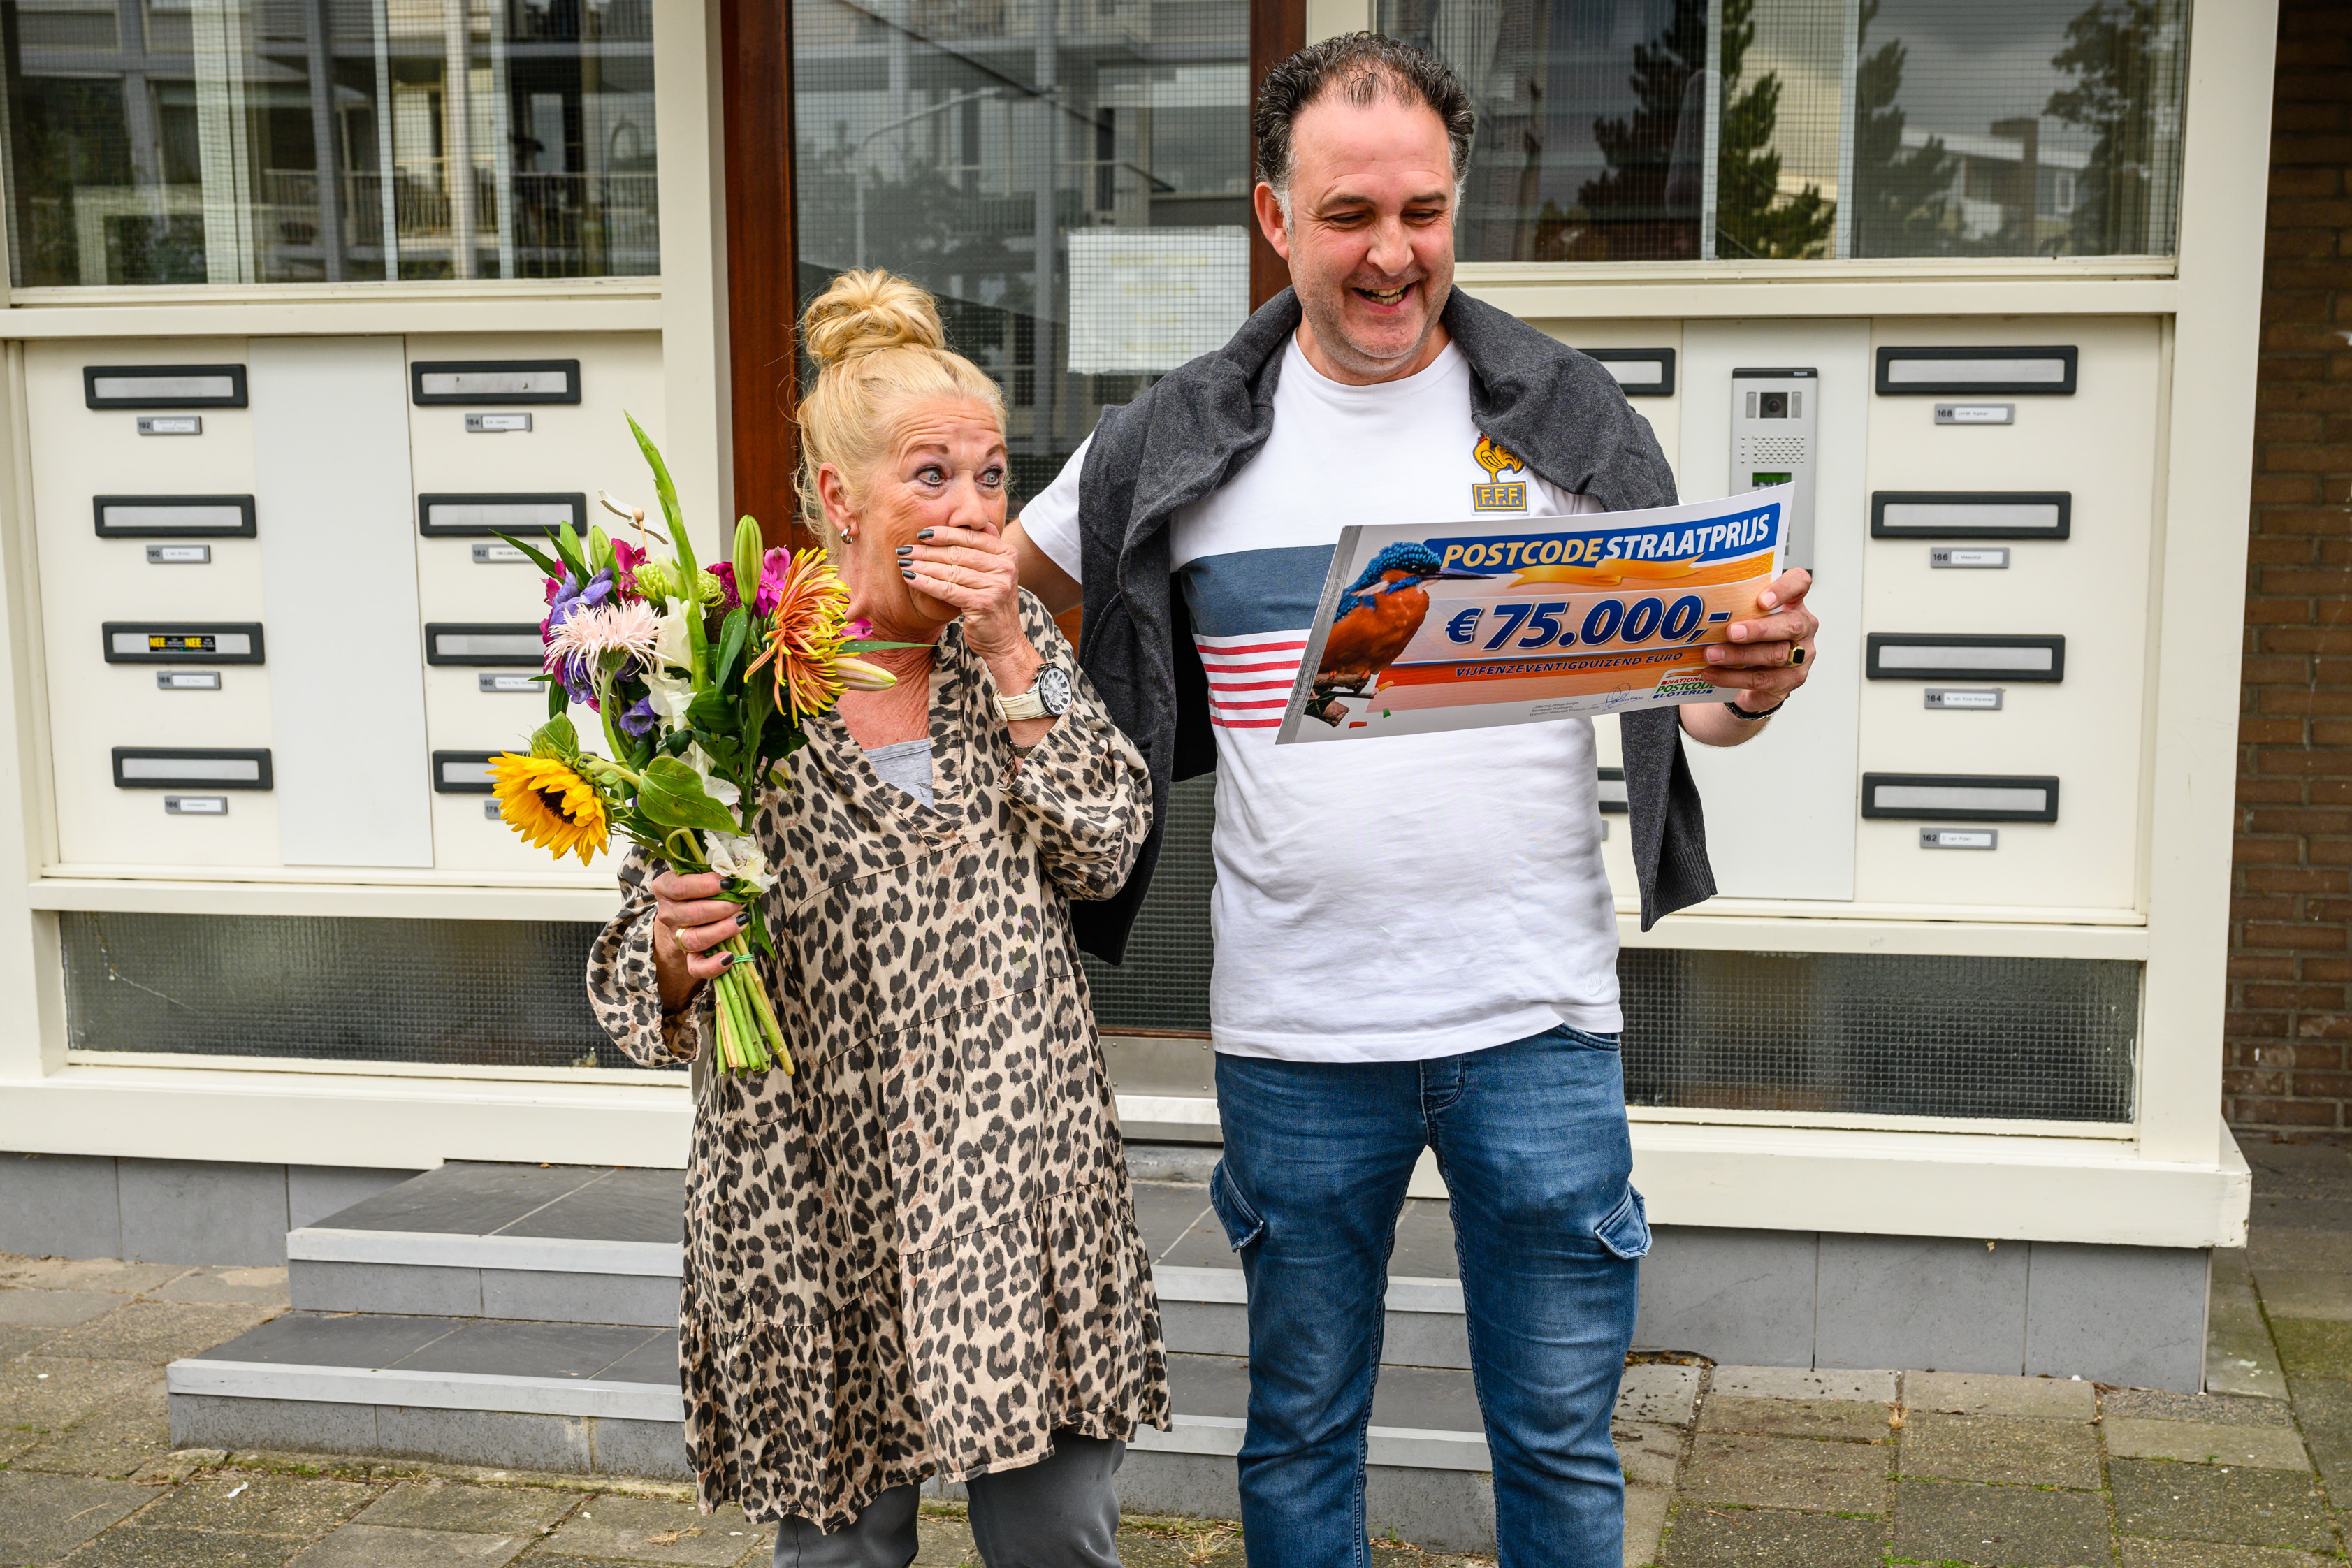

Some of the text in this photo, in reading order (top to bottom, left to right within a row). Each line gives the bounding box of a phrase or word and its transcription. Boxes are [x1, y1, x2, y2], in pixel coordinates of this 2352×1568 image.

[1937, 409, 1952, 418] 168
[1481, 488, 1520, 505] F.F.F.
[473, 549, 487, 558] 182
[1933, 553, 1948, 561] 166
[149, 637, 166, 648] NEE
[184, 637, 202, 648] NEE
[1456, 653, 1683, 677] VIJFENZEVENTIGDUIZEND EURO
[480, 678, 494, 687] 180
[1659, 690, 1707, 699] LOTERIJ
[1923, 834, 1938, 843] 162
